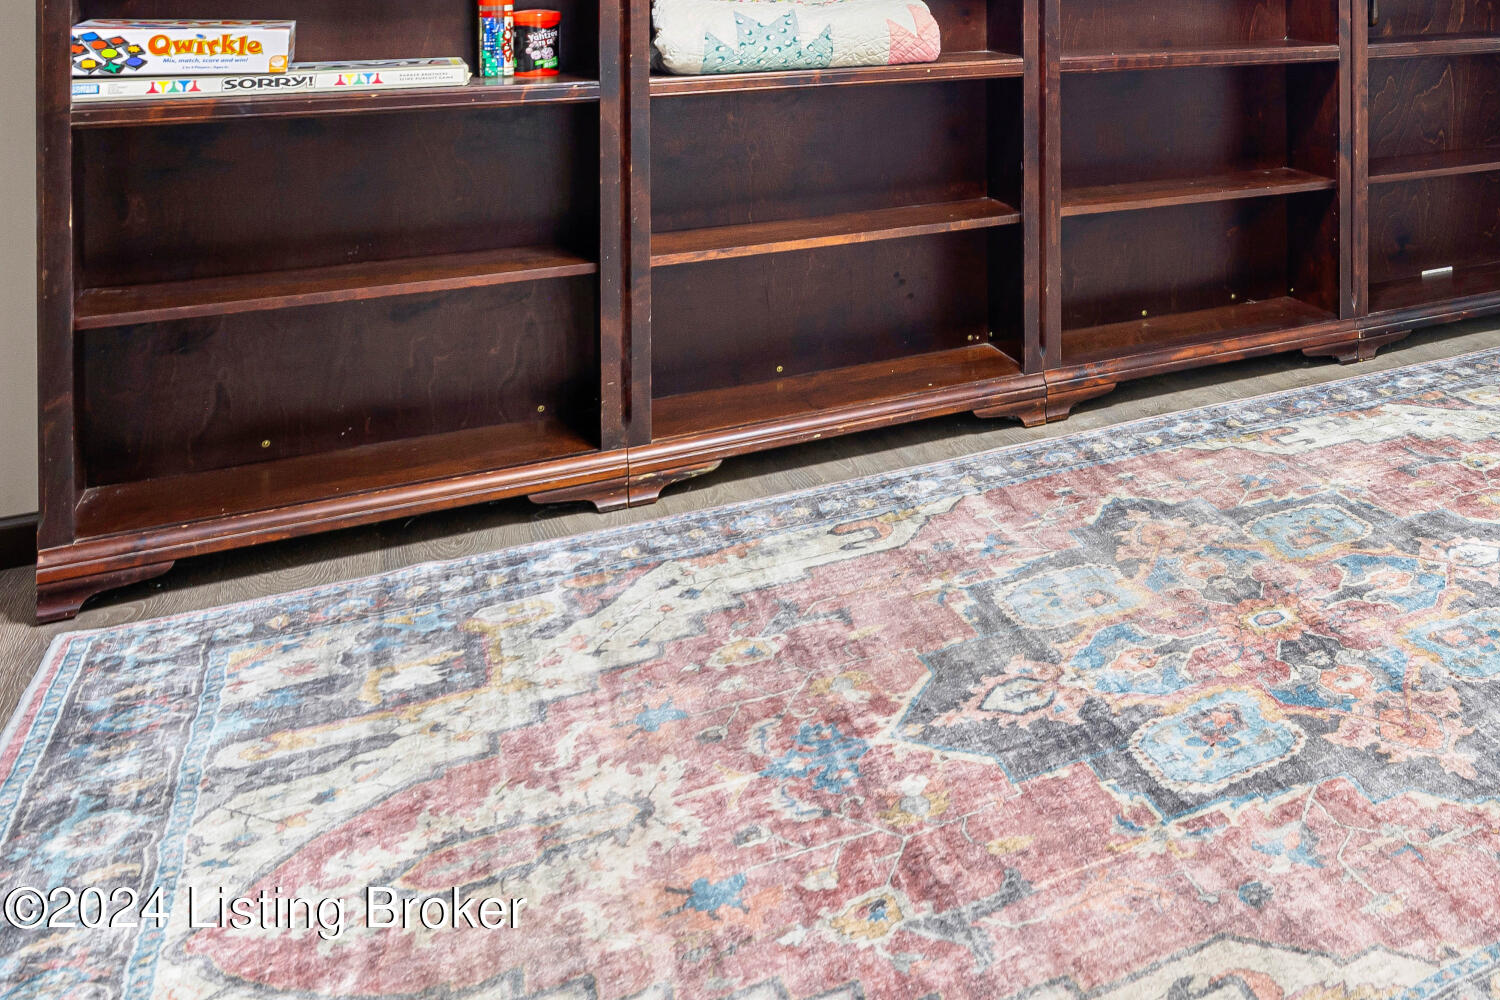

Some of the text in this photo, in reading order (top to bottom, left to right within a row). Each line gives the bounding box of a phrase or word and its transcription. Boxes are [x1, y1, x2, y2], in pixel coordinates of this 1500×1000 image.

[527, 28, 558, 43] Yahtzee
[148, 33, 263, 57] Qwirkle
[224, 76, 313, 90] SORRY!
